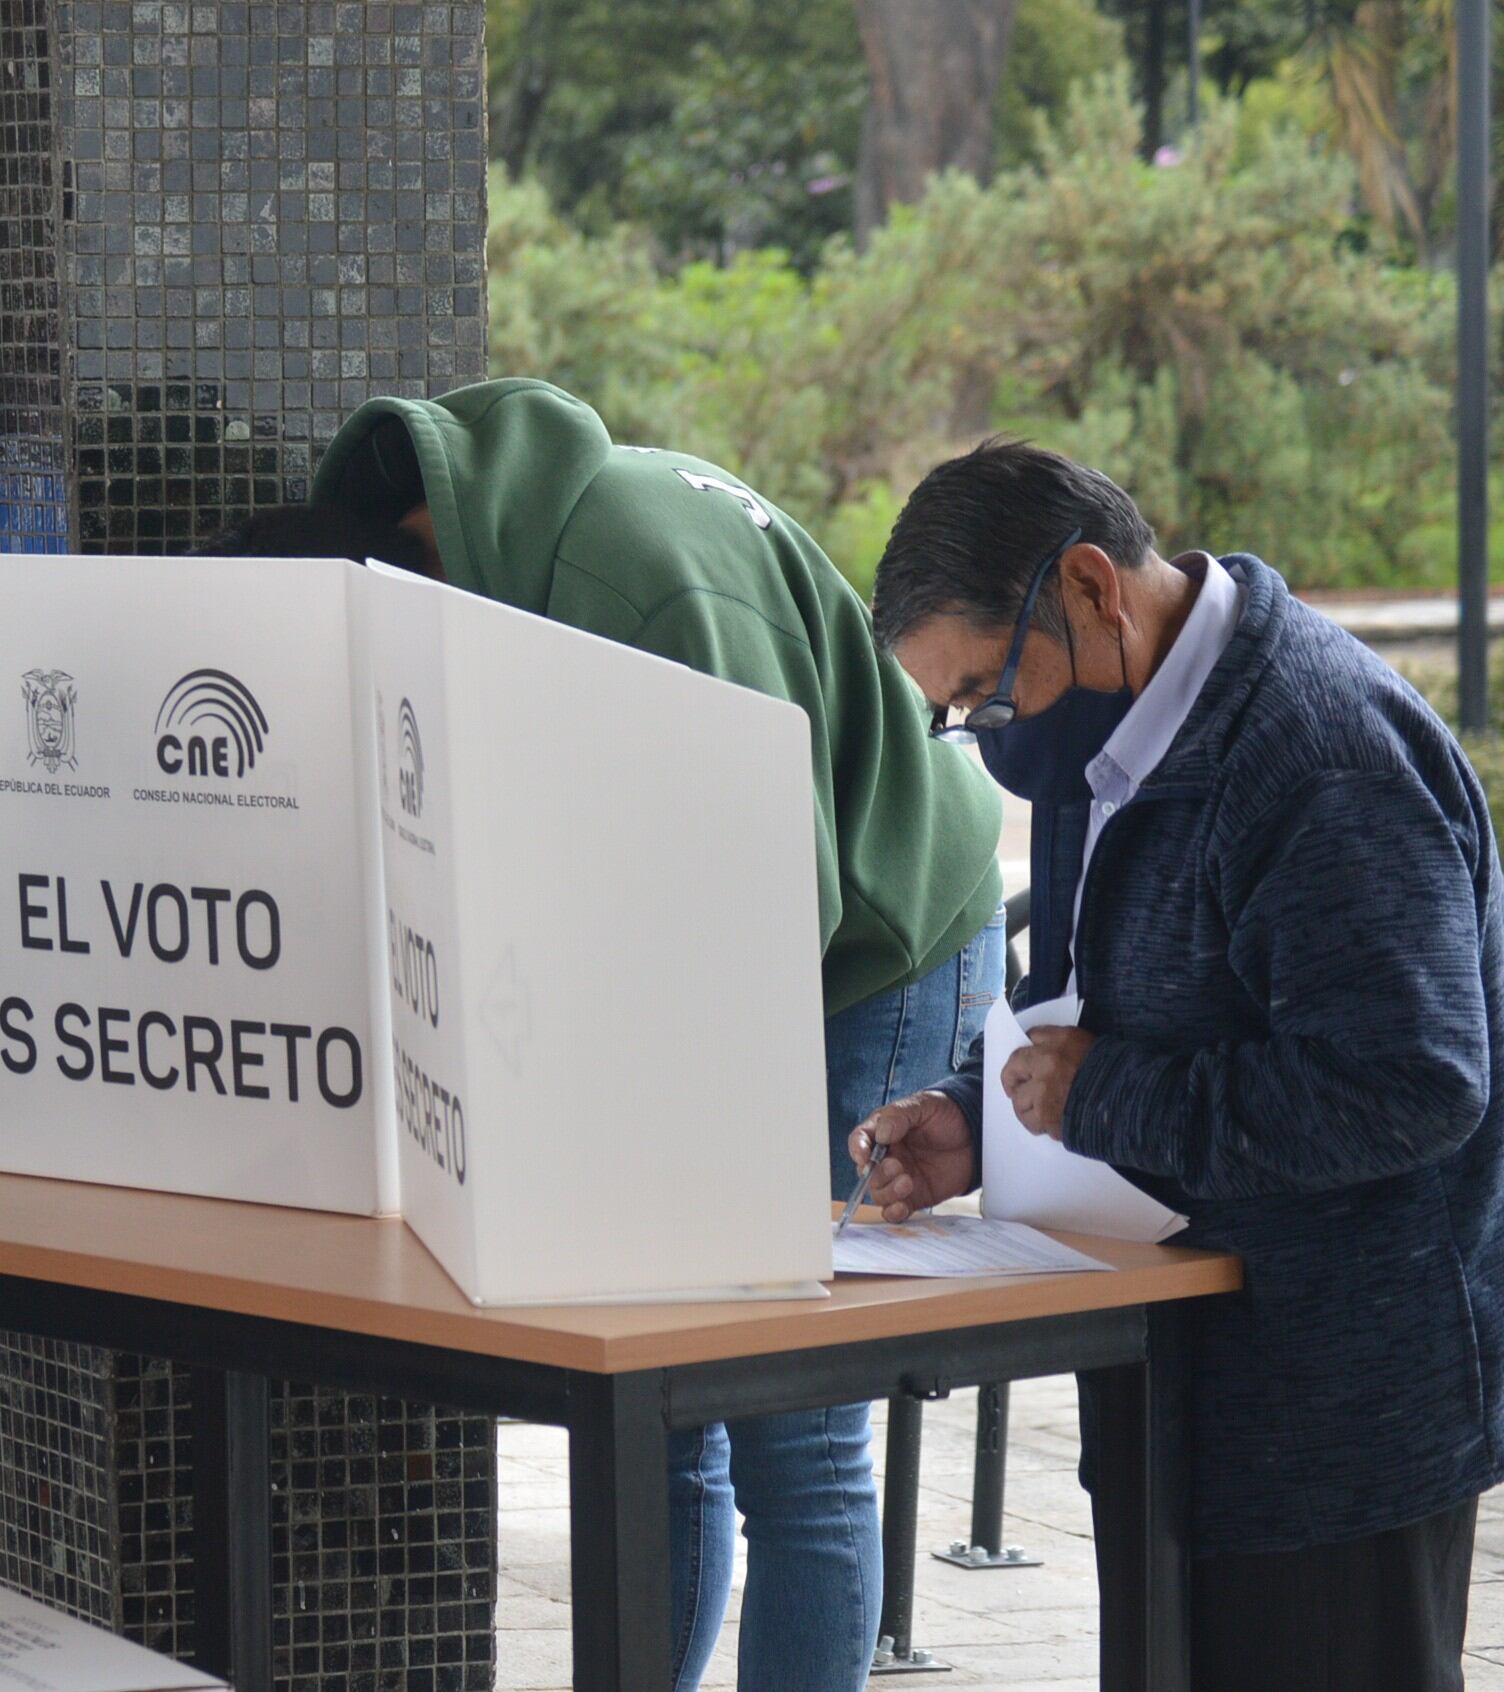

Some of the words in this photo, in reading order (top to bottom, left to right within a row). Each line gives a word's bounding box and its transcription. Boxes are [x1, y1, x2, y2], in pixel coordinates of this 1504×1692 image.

[44, 782, 63, 796] DEL
[64, 784, 110, 798] ECUADOR
[133, 788, 181, 803] CONSEJO
[182, 791, 235, 806] NACIONAL
[237, 794, 300, 809] ELECTORAL
[18, 873, 91, 954] EL
[100, 879, 281, 971] VOTO
[399, 919, 439, 1029] VOTO
[54, 1001, 363, 1109] SECRETO
[401, 1049, 466, 1187] SECRETO
